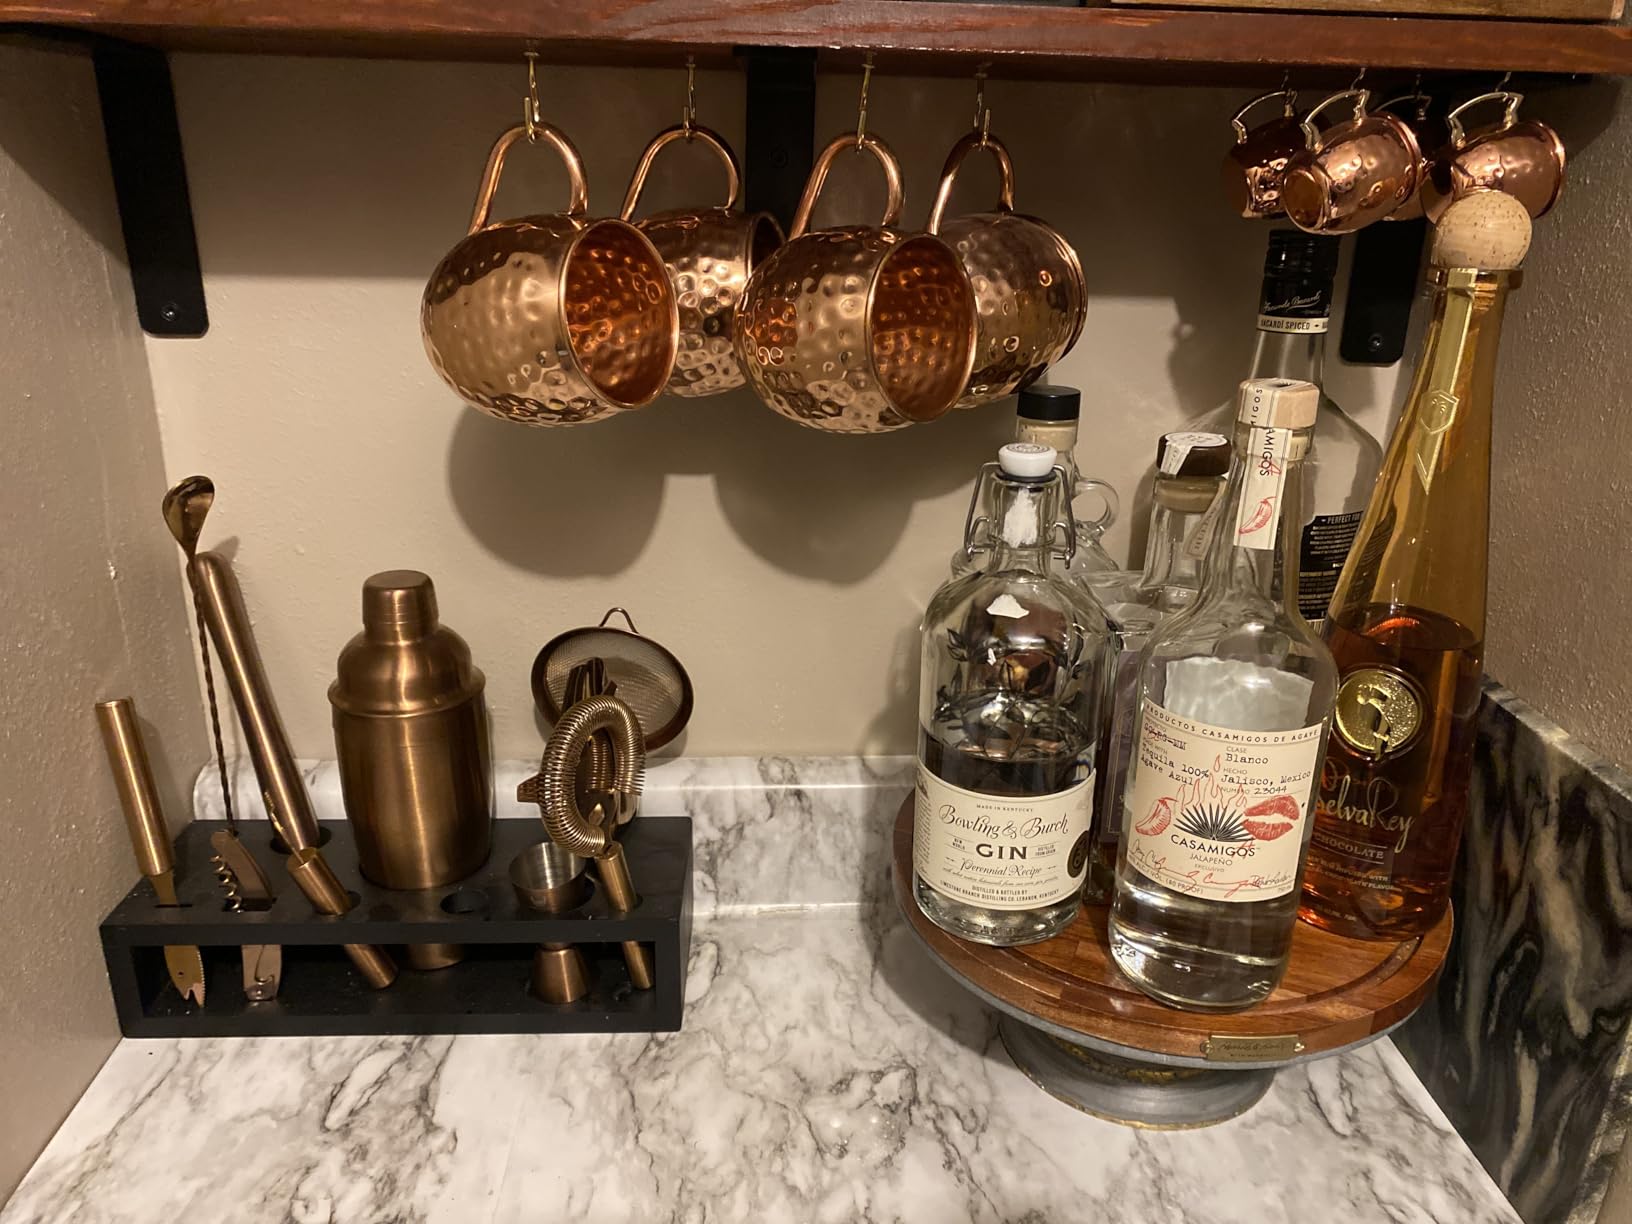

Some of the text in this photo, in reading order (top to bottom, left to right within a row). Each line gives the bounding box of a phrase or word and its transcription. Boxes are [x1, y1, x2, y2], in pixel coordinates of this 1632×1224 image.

[1286, 321, 1311, 330] SPICED
[1146, 703, 1196, 732] PRODUCTOS
[1201, 728, 1268, 743] CASAMIGOS
[1291, 729, 1319, 741] AGAVE
[1226, 745, 1247, 754] CLASE
[1143, 742, 1175, 768] Tequila
[1181, 763, 1209, 779] 100%
[1225, 753, 1269, 765] Blanco
[1141, 754, 1194, 786] Agave Azul
[1221, 771, 1311, 786] Jalisco, Mexico
[1223, 767, 1248, 775] HECHO
[1254, 785, 1287, 795] 23044
[939, 804, 1069, 840] Bowling & Burch
[976, 843, 1028, 860] GIN
[1171, 834, 1256, 857] CASAMIGOS
[1314, 832, 1385, 859] CHOCOLATE
[960, 857, 1008, 877] Perennial
[1009, 864, 1042, 879] Recipe
[1190, 853, 1233, 866] JALAPEÑO
